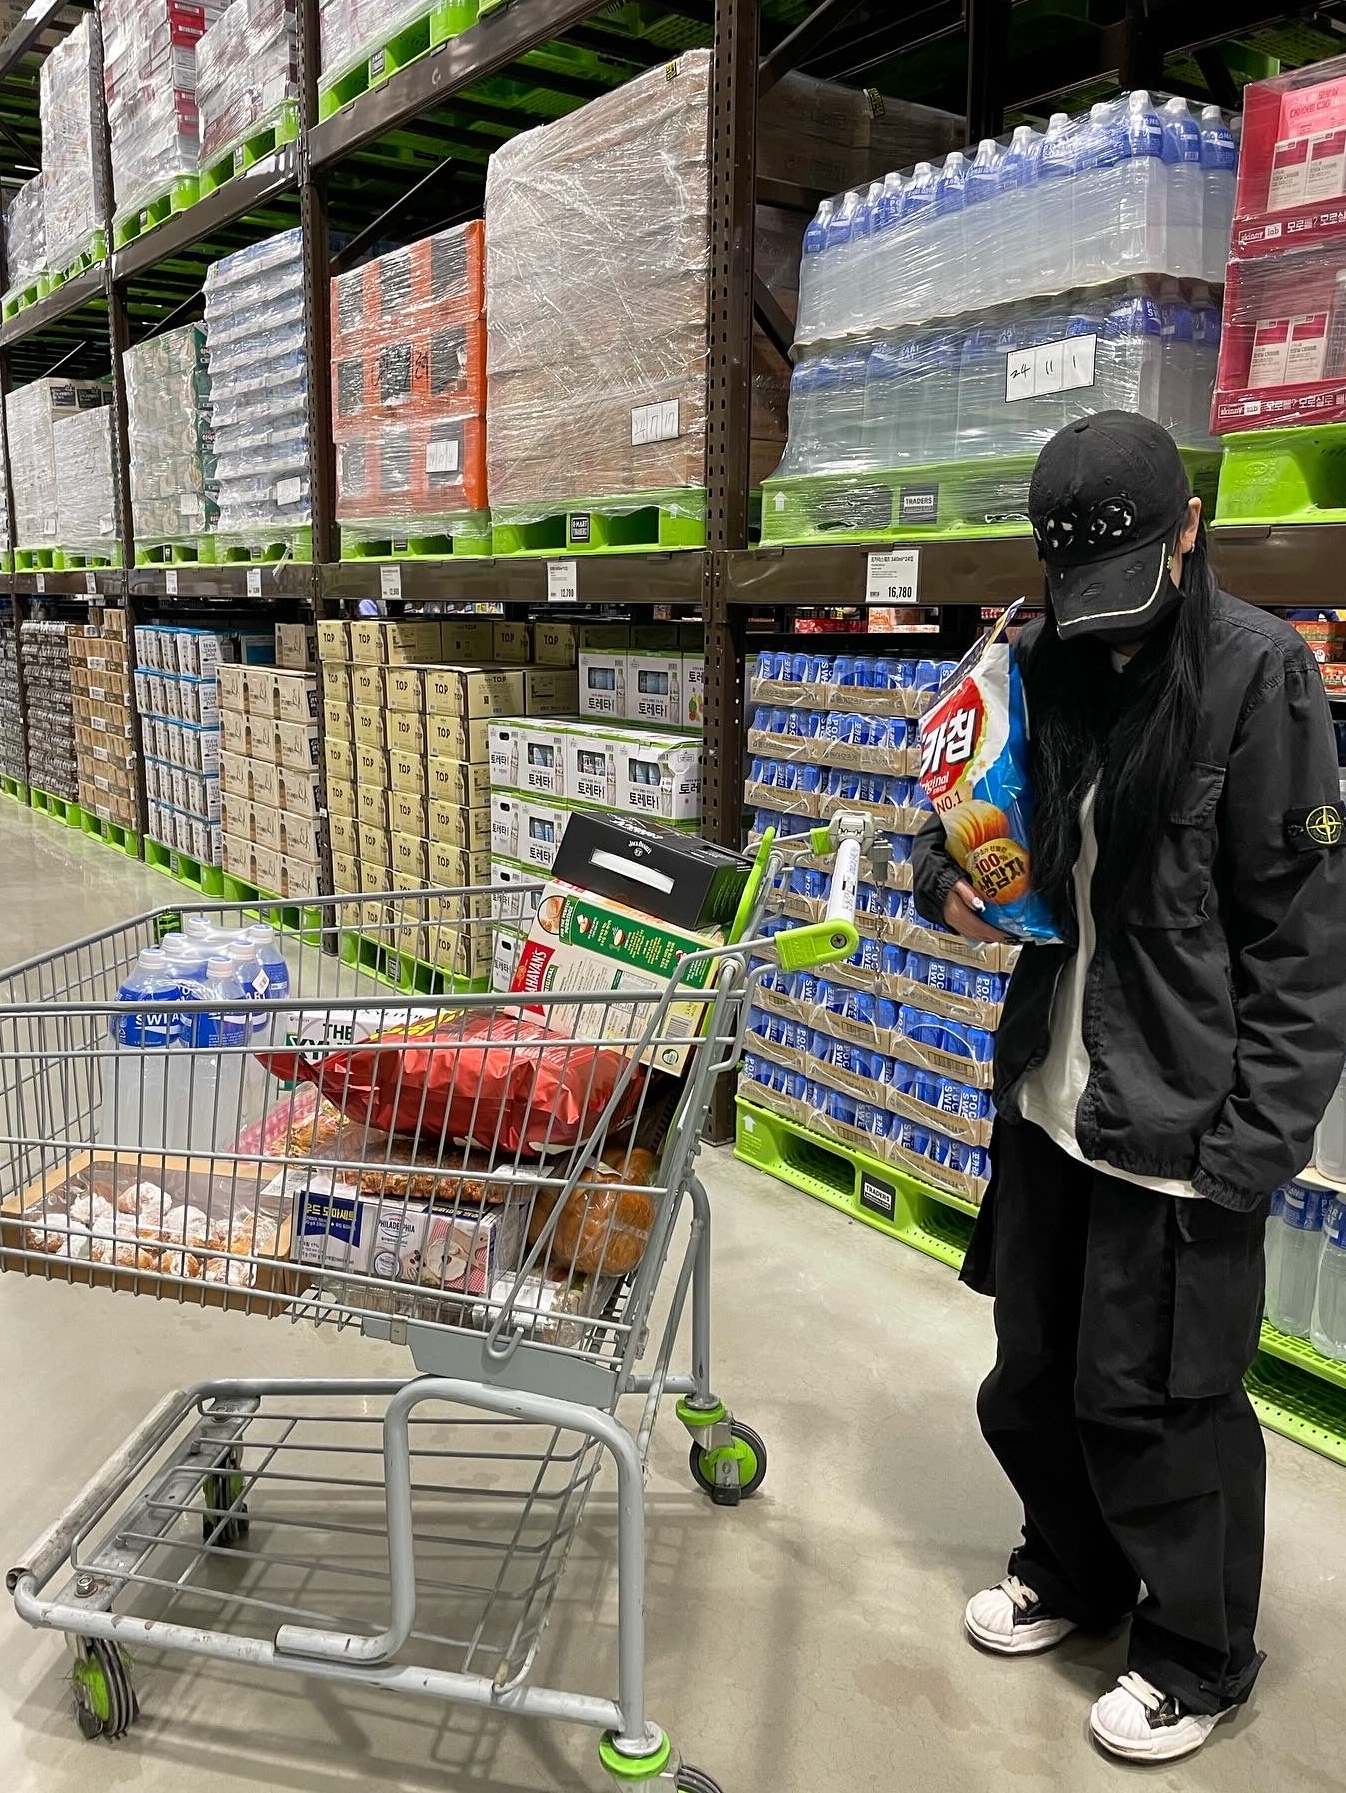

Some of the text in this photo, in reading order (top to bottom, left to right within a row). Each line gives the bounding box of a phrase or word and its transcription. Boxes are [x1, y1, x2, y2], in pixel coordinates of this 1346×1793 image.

[1009, 363, 1031, 379] 24
[905, 496, 933, 505] TRADERS
[888, 586, 912, 599] 16,780
[323, 633, 335, 642] TOP
[359, 633, 370, 644] TOP
[501, 633, 514, 643] TOP
[544, 635, 558, 645] TOP
[328, 673, 338, 683] TOP
[359, 677, 370, 687] TOP
[396, 680, 408, 691] TOP
[435, 684, 448, 695] TOP
[330, 712, 339, 722] TOP
[361, 717, 372, 727] TOP
[398, 722, 410, 733] TOP
[437, 727, 450, 738] TOP
[331, 750, 341, 760] TOP
[362, 757, 374, 768] TOP
[398, 764, 410, 775] TOP
[435, 771, 448, 783] TOP
[920, 771, 949, 795] riginal
[332, 788, 343, 798] TOP
[363, 795, 374, 807] TOP
[936, 791, 963, 815] NO.1
[399, 805, 411, 816] TOP
[437, 813, 450, 825] TOP
[334, 825, 344, 836] TOP
[365, 835, 376, 846] TOP
[399, 845, 411, 857] TOP
[437, 855, 450, 867] TOP
[337, 862, 347, 873] TOP
[366, 873, 377, 885] TOP
[367, 911, 378, 922] TOP
[439, 938, 451, 950] TOP
[521, 951, 547, 993] AHAVAN'S
[937, 965, 945, 989] POC
[543, 968, 555, 992] RIGINAL
[805, 979, 813, 1002] SWE
[322, 1023, 353, 1040] THE
[944, 1085, 952, 1112] SWE
[969, 1094, 977, 1119] POC
[866, 1184, 891, 1203] TRADERS
[379, 1220, 416, 1233] PHILADEPHIA
